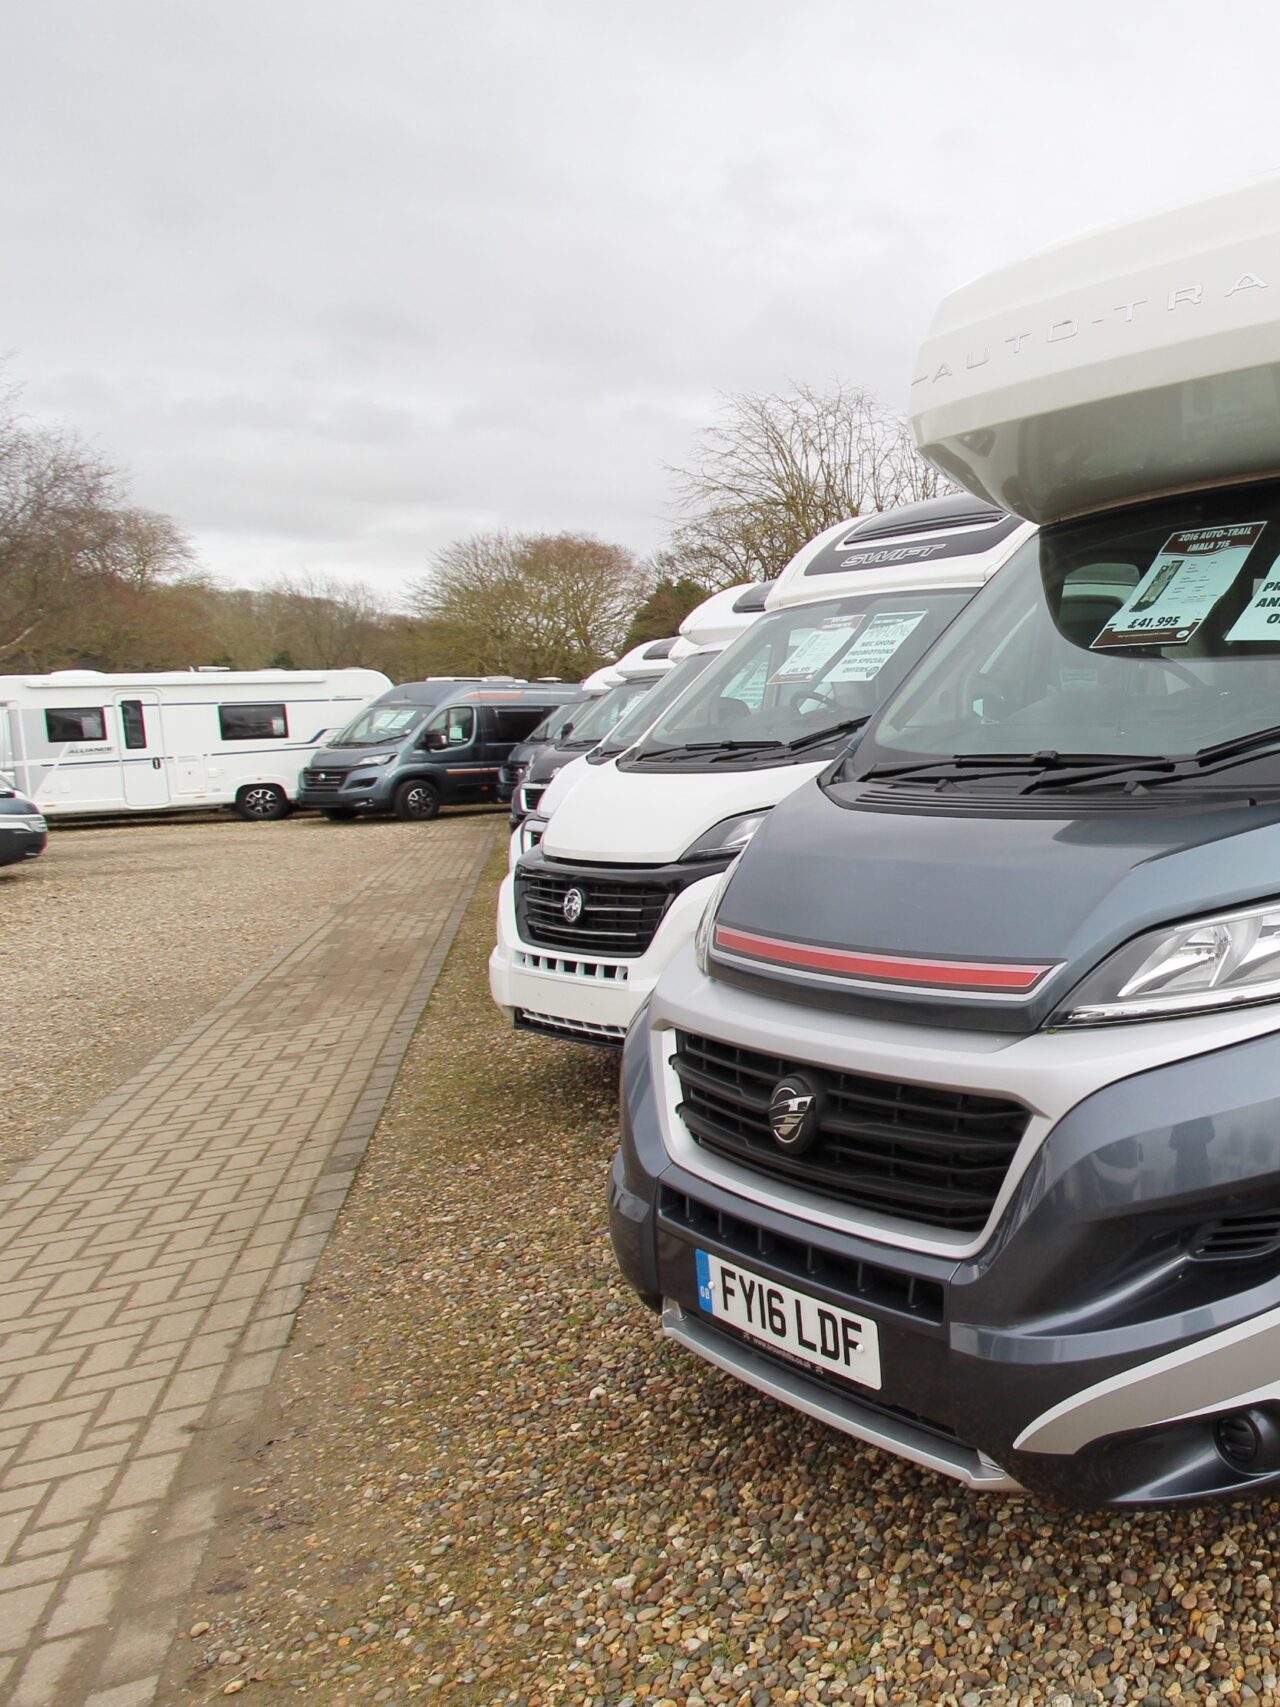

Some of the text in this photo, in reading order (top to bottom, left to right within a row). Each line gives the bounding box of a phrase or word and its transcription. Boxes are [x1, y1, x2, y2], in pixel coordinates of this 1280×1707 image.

[1178, 526, 1253, 542] 2016 AUTO-TRAIL
[1187, 540, 1232, 552] IMALA 715
[840, 543, 947, 567] SWIFT
[700, 1286, 710, 1300] GB
[720, 1266, 863, 1367] FY16 LDF
